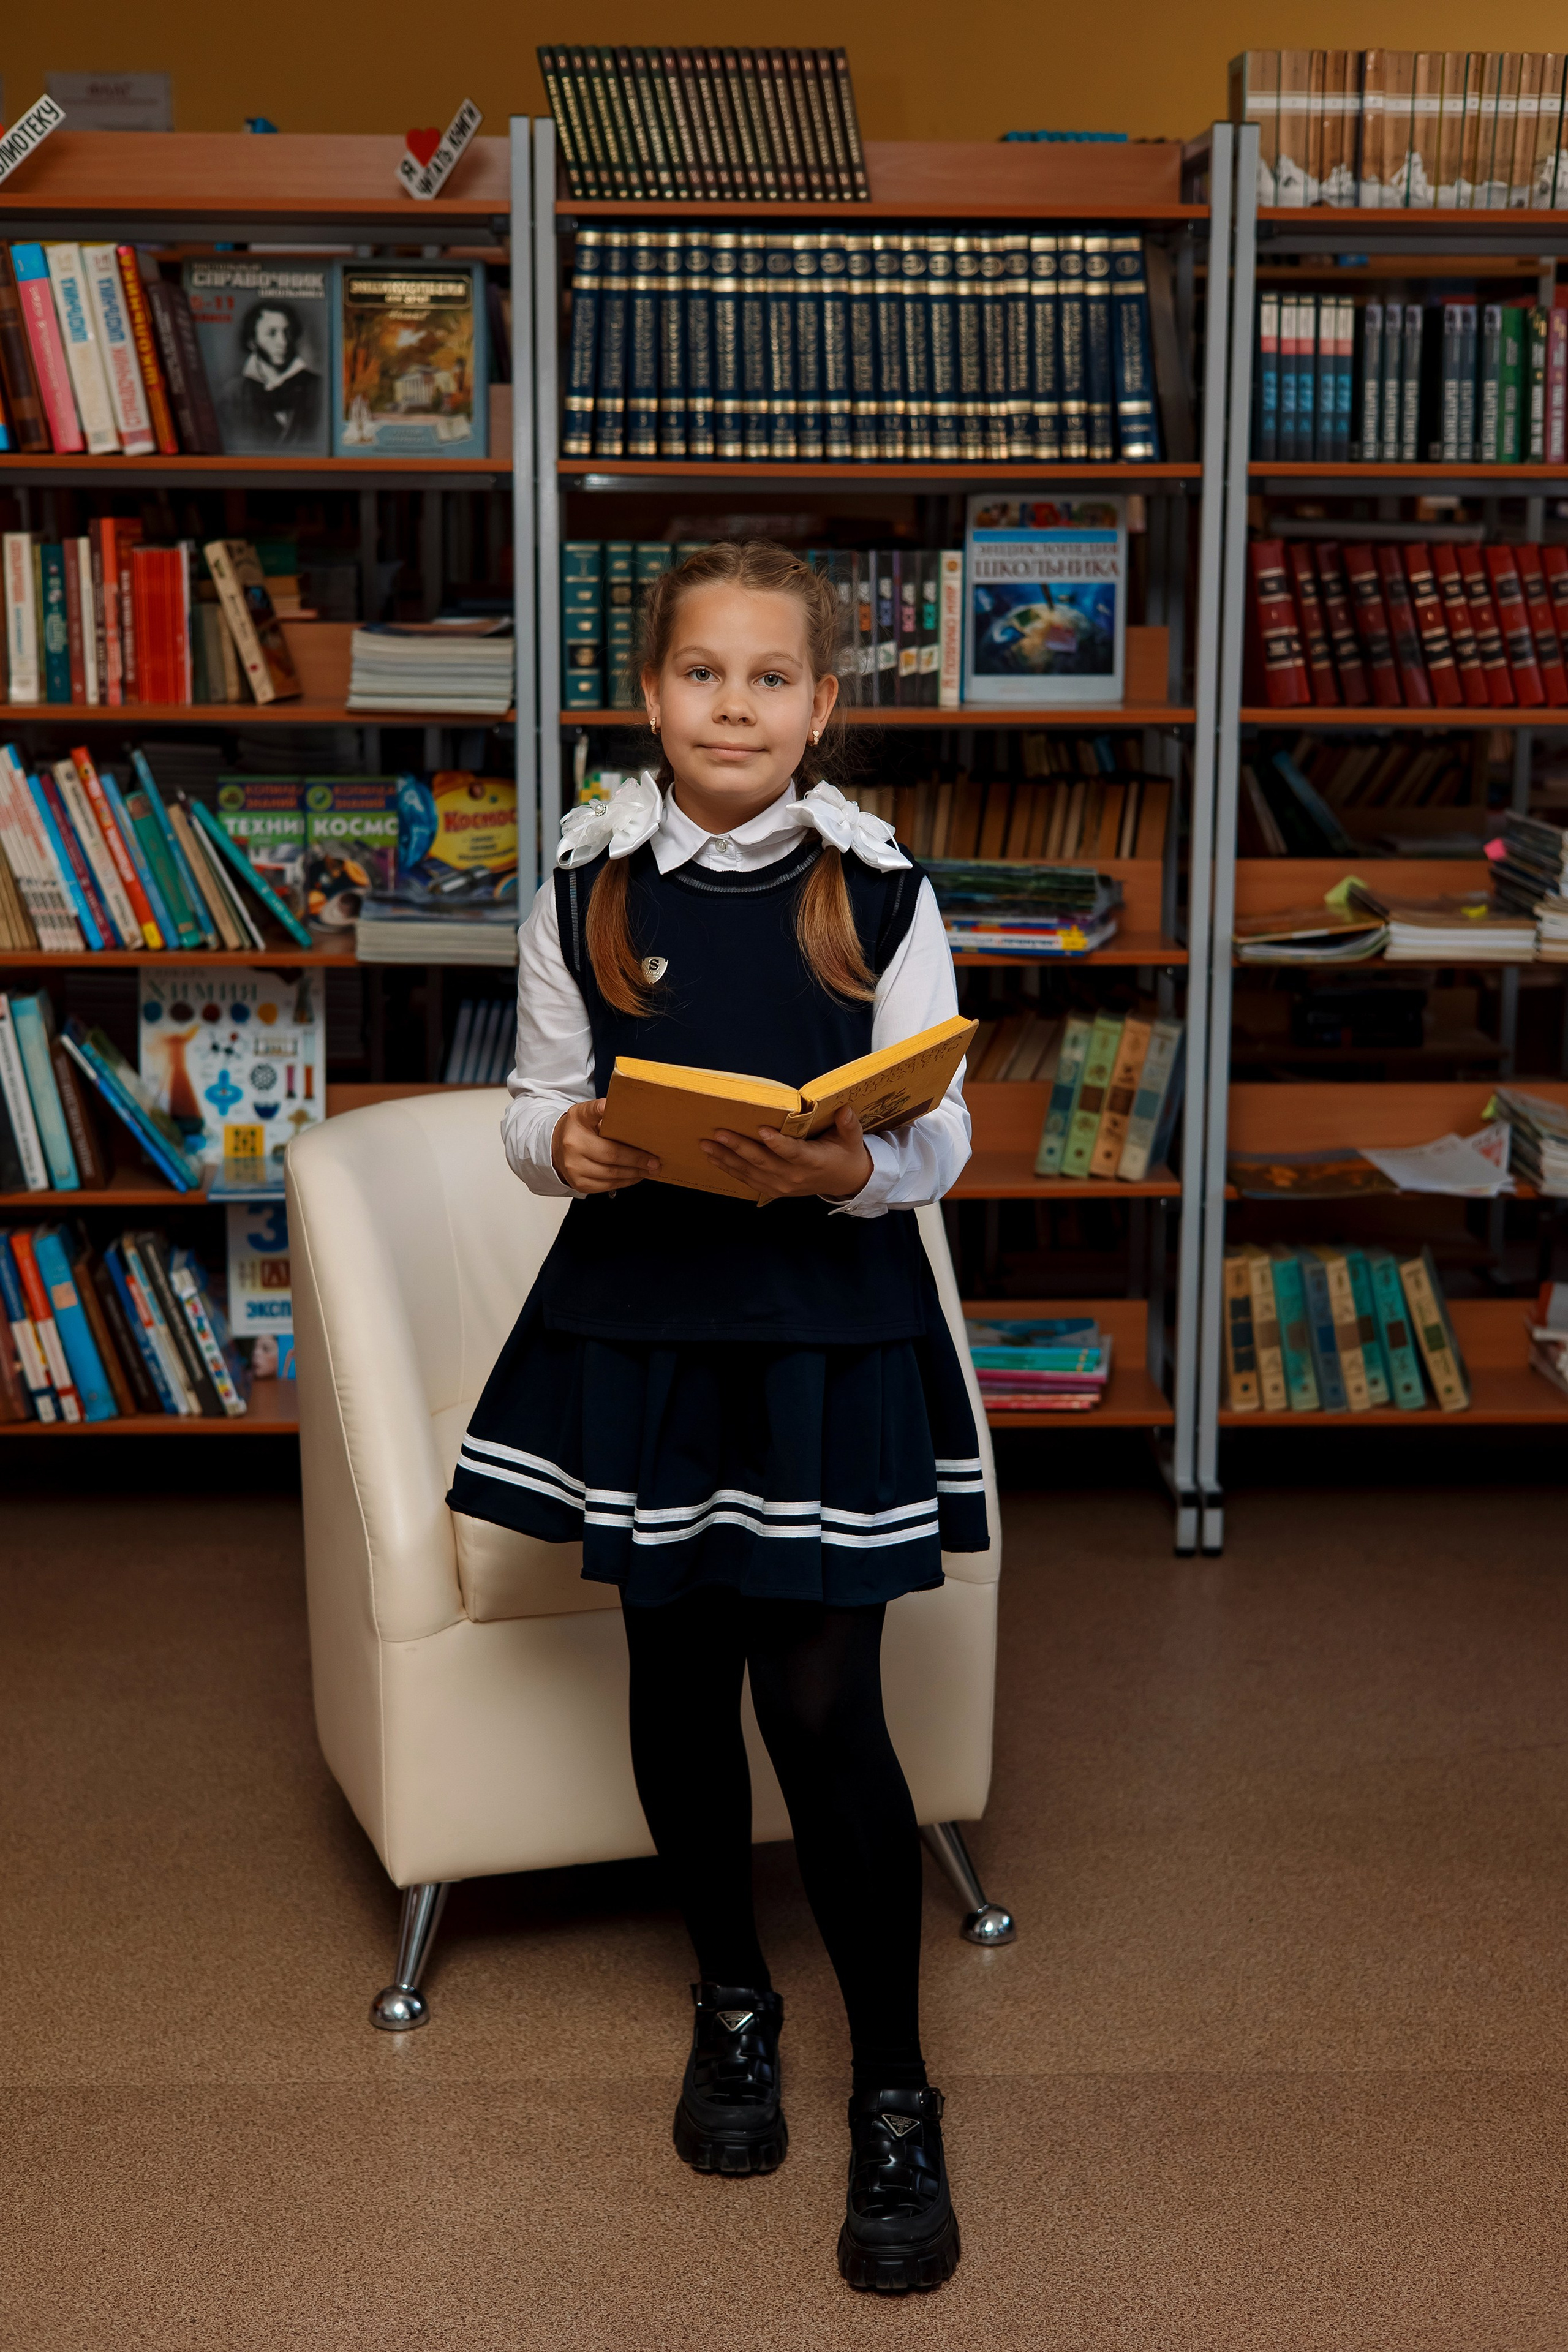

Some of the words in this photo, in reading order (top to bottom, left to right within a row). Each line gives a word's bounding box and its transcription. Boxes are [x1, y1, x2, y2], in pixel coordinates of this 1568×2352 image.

[192, 271, 325, 287] СПРАВОЧНИК
[974, 557, 1120, 577] ШКОЛЬНИКА
[649, 958, 660, 971] S
[891, 2116, 912, 2125] BRAND
